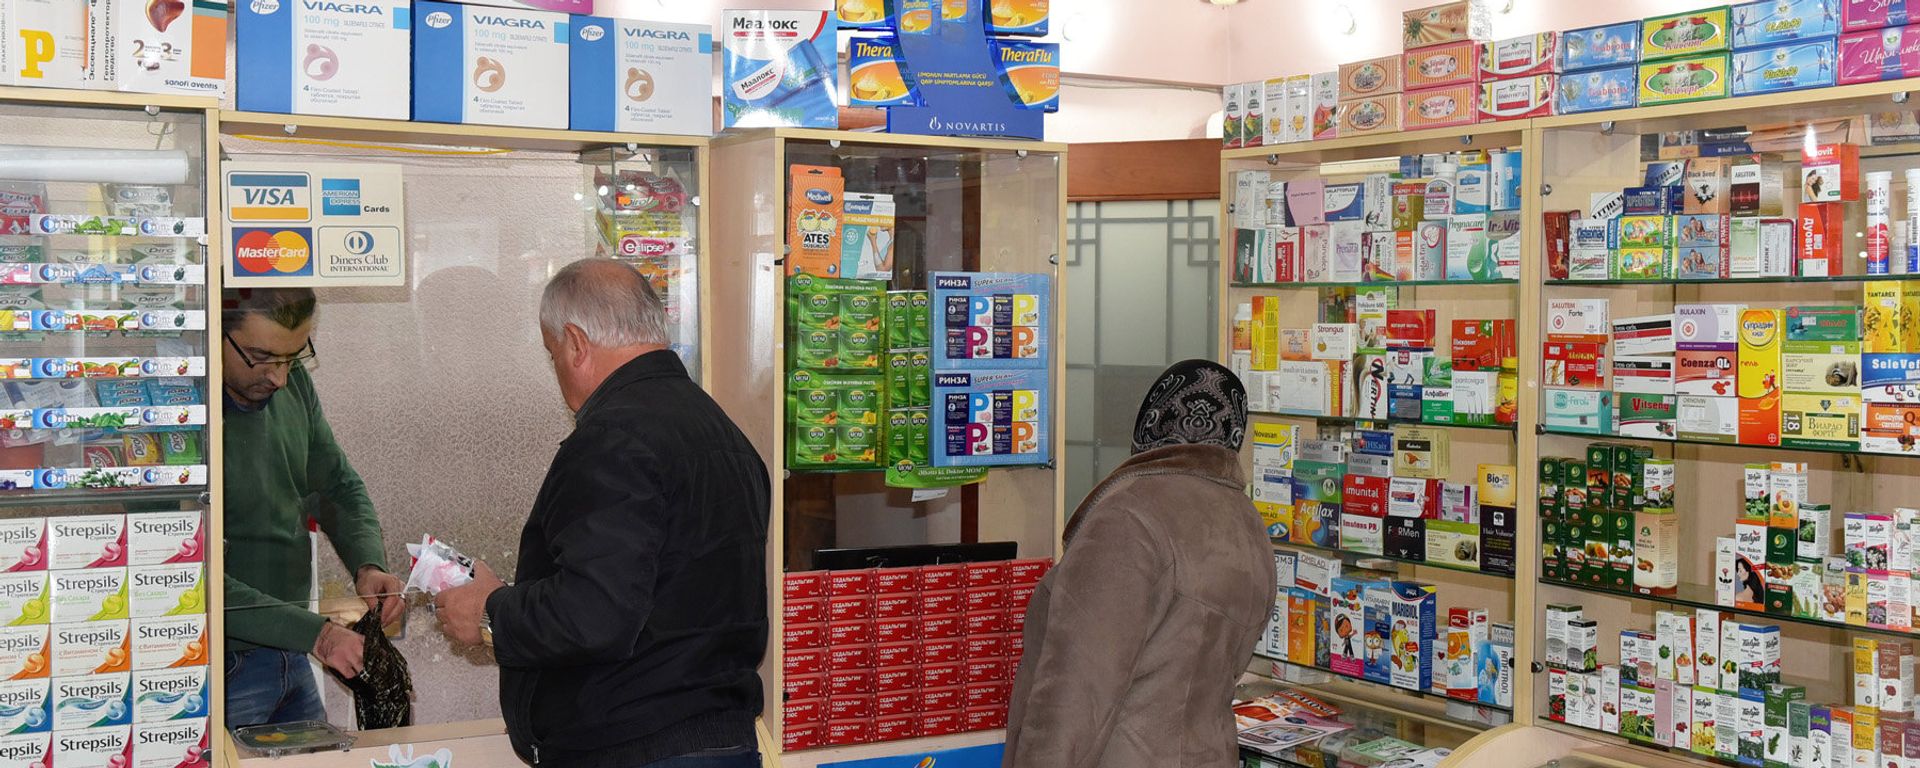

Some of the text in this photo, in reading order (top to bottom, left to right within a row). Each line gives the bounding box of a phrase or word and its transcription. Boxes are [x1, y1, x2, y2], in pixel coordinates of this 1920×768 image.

[304, 1, 382, 15] VIAGRA
[305, 15, 320, 27] 100
[324, 17, 339, 28] mg
[427, 14, 451, 29] Pfizer
[474, 15, 545, 30] VIAGRA
[474, 28, 489, 40] 100
[491, 31, 506, 43] mg
[582, 28, 604, 42] Pfizer
[624, 28, 690, 41] VIAGRA
[625, 41, 640, 52] 100
[642, 43, 655, 54] mg
[1001, 47, 1052, 63] TheraFlu
[164, 79, 218, 90] sanofi aventis
[946, 121, 1006, 132] NOVARTIS
[244, 188, 295, 205] VISA
[331, 198, 361, 206] EXPRESS
[363, 205, 391, 214] Cards
[238, 247, 307, 260] MasterCard
[329, 254, 389, 266] Diners Club
[329, 265, 389, 273] INTERNATIONAL
[938, 280, 967, 288] РИНЗА
[1680, 308, 1706, 316] BULAXIN
[1318, 325, 1344, 340] Strongus
[938, 376, 967, 386] РИНЗА
[55, 521, 117, 540] Strepsils
[134, 517, 193, 536] Strepsils
[1739, 531, 1761, 546] Talya
[57, 574, 119, 594] Strepsils
[135, 569, 195, 589] Strepsils
[59, 628, 121, 648] Strepsils
[138, 622, 199, 641] Strepsils
[60, 682, 122, 702] Strepsils
[139, 676, 199, 695] Strepsils
[60, 736, 122, 755] Strepsils
[139, 728, 199, 748] Strepsils
